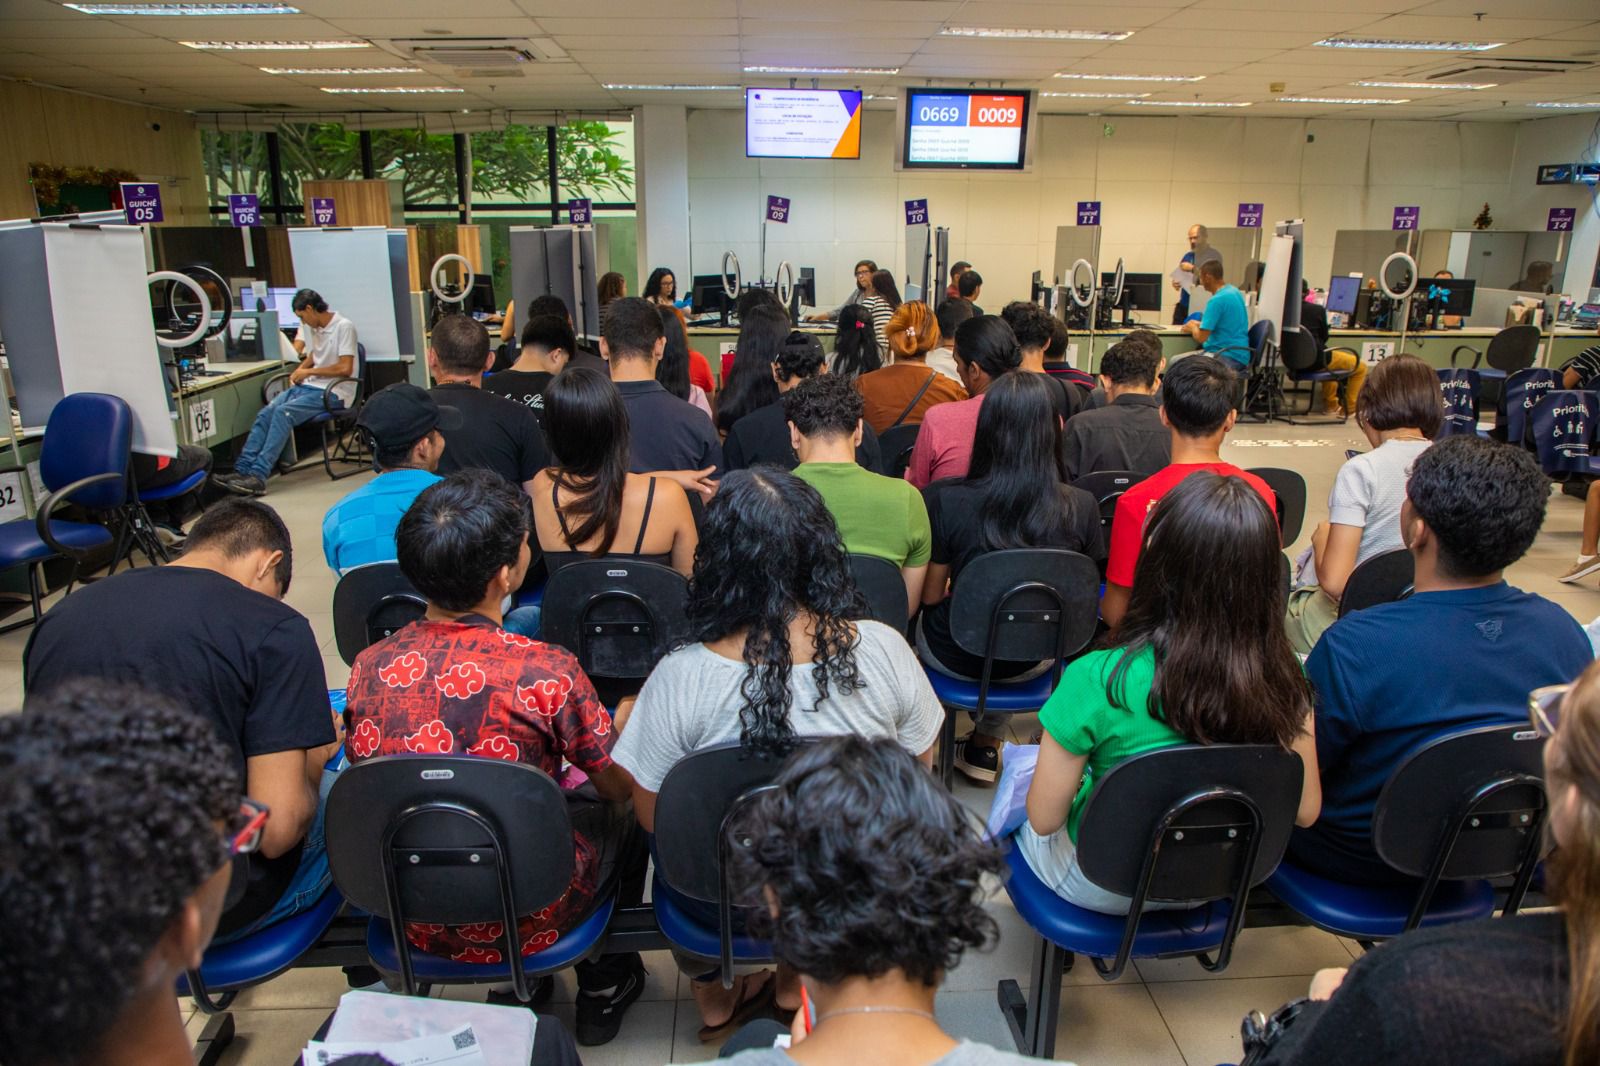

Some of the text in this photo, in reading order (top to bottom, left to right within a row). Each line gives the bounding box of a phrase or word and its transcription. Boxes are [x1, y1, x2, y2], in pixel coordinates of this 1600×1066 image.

[920, 107, 959, 122] 0669
[978, 108, 1017, 123] 0009
[129, 198, 157, 208] GUICHÊ
[135, 208, 154, 220] 05
[239, 214, 254, 223] 06
[319, 214, 331, 222] 07
[772, 211, 784, 220] 09
[912, 214, 923, 222] 10
[1082, 216, 1094, 224] 11
[1243, 217, 1256, 225] 12
[1399, 220, 1411, 228] 13
[1553, 221, 1567, 229] 14
[1368, 348, 1386, 362] 13
[196, 411, 210, 432] 06
